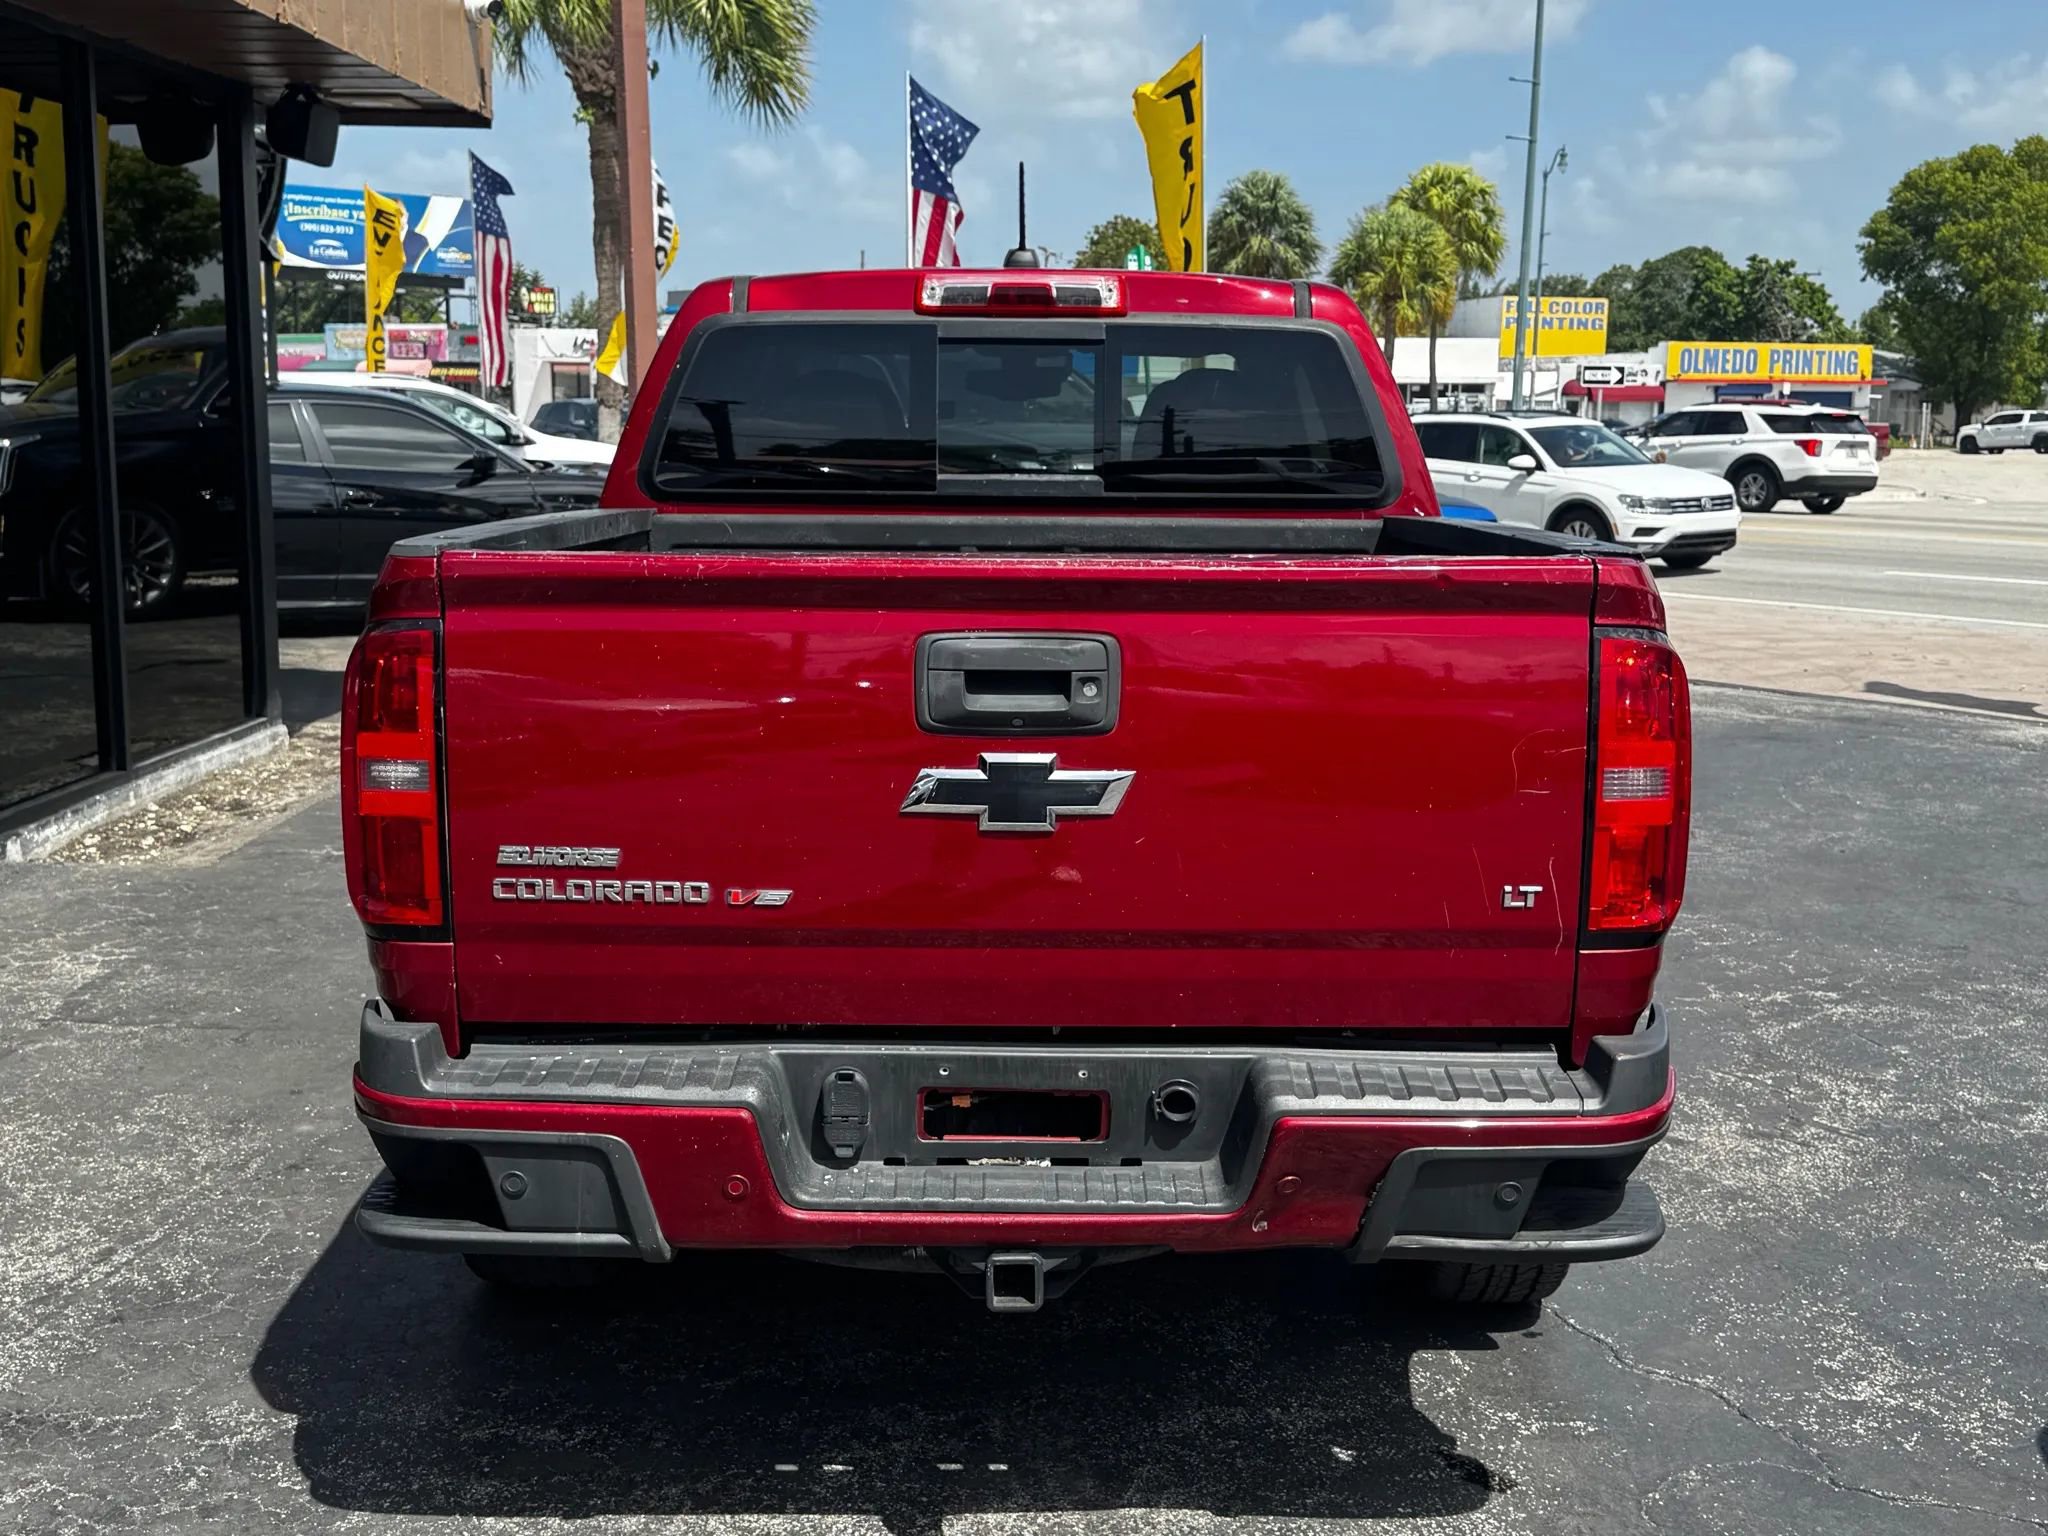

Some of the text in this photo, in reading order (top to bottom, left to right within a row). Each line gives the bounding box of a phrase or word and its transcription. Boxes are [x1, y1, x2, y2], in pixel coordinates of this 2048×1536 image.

[1549, 301, 1605, 315] COLOR
[1505, 316, 1604, 331] PNTING
[1679, 347, 1859, 376] OLMEDO PRINTING
[493, 877, 794, 906] COLORADO V6
[1503, 886, 1544, 908] LT
